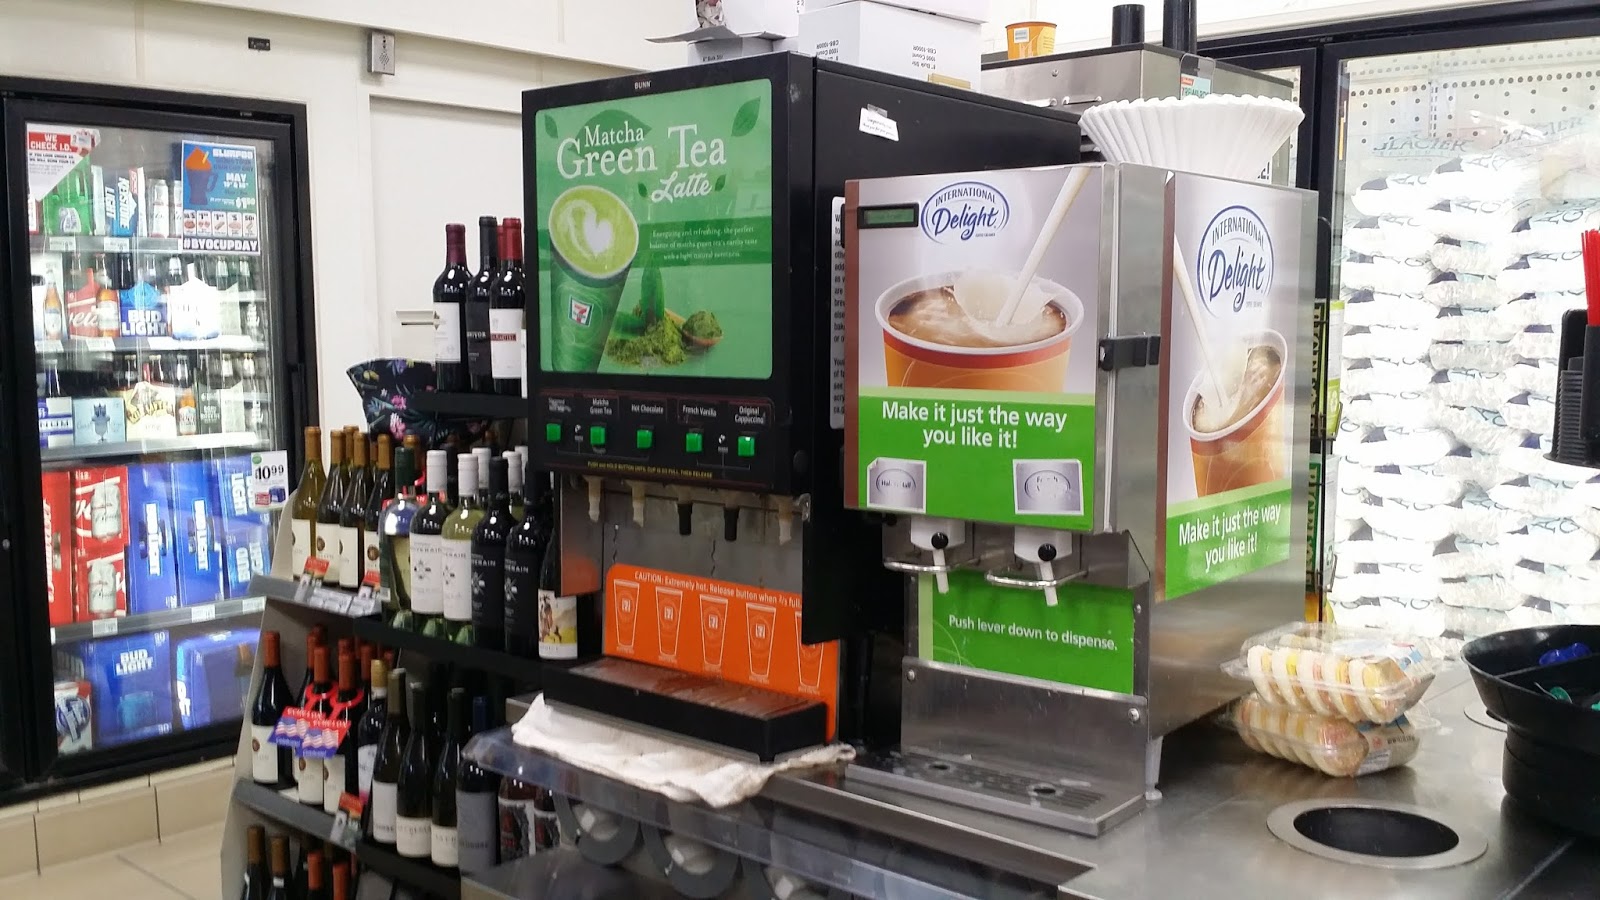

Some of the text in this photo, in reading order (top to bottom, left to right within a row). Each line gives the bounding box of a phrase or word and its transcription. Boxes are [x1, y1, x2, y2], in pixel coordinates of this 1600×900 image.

[635, 81, 651, 89] BUNN
[44, 134, 58, 142] WE
[584, 121, 644, 148] Matcha
[30, 141, 57, 150] CHECK
[557, 124, 726, 179] Green Tea
[226, 173, 246, 182] MAY
[651, 171, 713, 204] Latte
[935, 187, 996, 207] INTERNATIONAL
[932, 203, 999, 240] Delight
[734, 225, 754, 235] perfect
[1212, 216, 1264, 250] INTERNATIONAL
[184, 238, 258, 251] #BYOCUPDAY
[697, 241, 712, 249] green
[1208, 245, 1266, 312] Delight
[128, 310, 161, 322] BUD
[122, 322, 167, 336] LIGHT
[592, 398, 609, 407] Matcha
[641, 404, 663, 414] Chocolate
[590, 406, 612, 415] Green Tea
[683, 405, 716, 417] French Vanilla
[739, 406, 760, 415] Original
[882, 401, 1067, 433] Make it just the way
[734, 414, 764, 424] Cappuccino
[923, 427, 1018, 448] you like it!
[232, 473, 247, 514] LIGHT
[1179, 503, 1281, 546] Make it just the way
[1205, 532, 1258, 573] you like it!
[635, 571, 663, 584] CAUTION:
[665, 575, 694, 591] Extremely
[696, 581, 708, 592] hot.
[710, 584, 734, 596] Release
[736, 588, 757, 600] button
[759, 592, 776, 603] when
[949, 614, 1118, 650] Push lever down to dispense.
[120, 649, 148, 663] BUD
[116, 657, 153, 676] LIGHT
